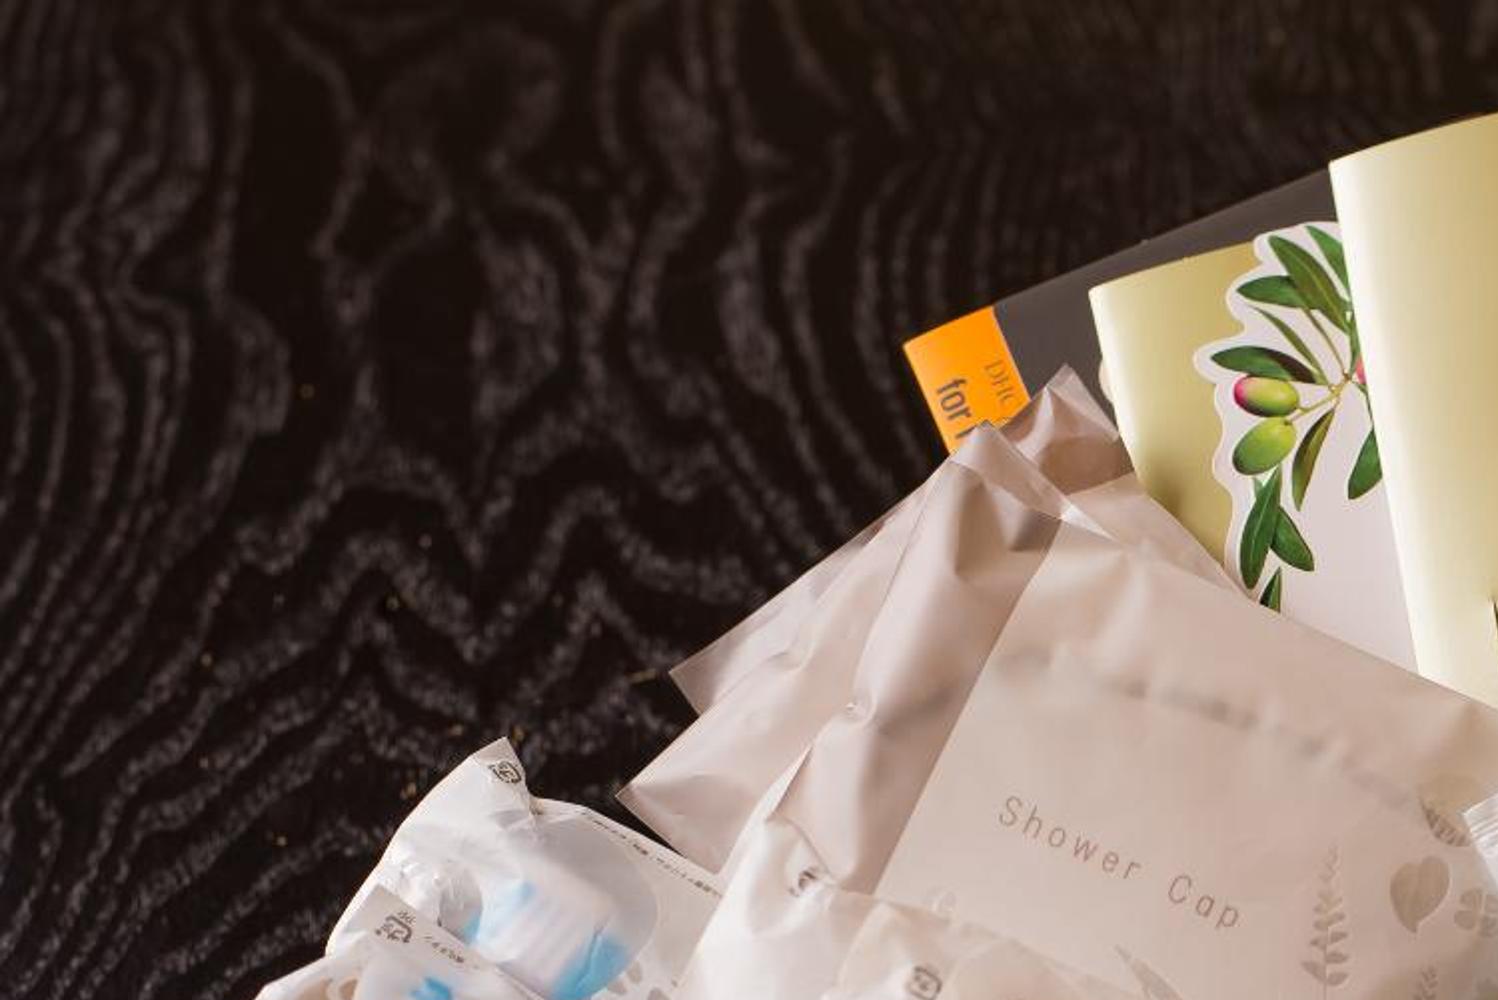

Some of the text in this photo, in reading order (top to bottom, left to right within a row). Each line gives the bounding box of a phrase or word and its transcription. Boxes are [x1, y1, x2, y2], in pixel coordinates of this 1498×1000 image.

[937, 378, 972, 420] for
[999, 795, 1239, 929] Shower Cap
